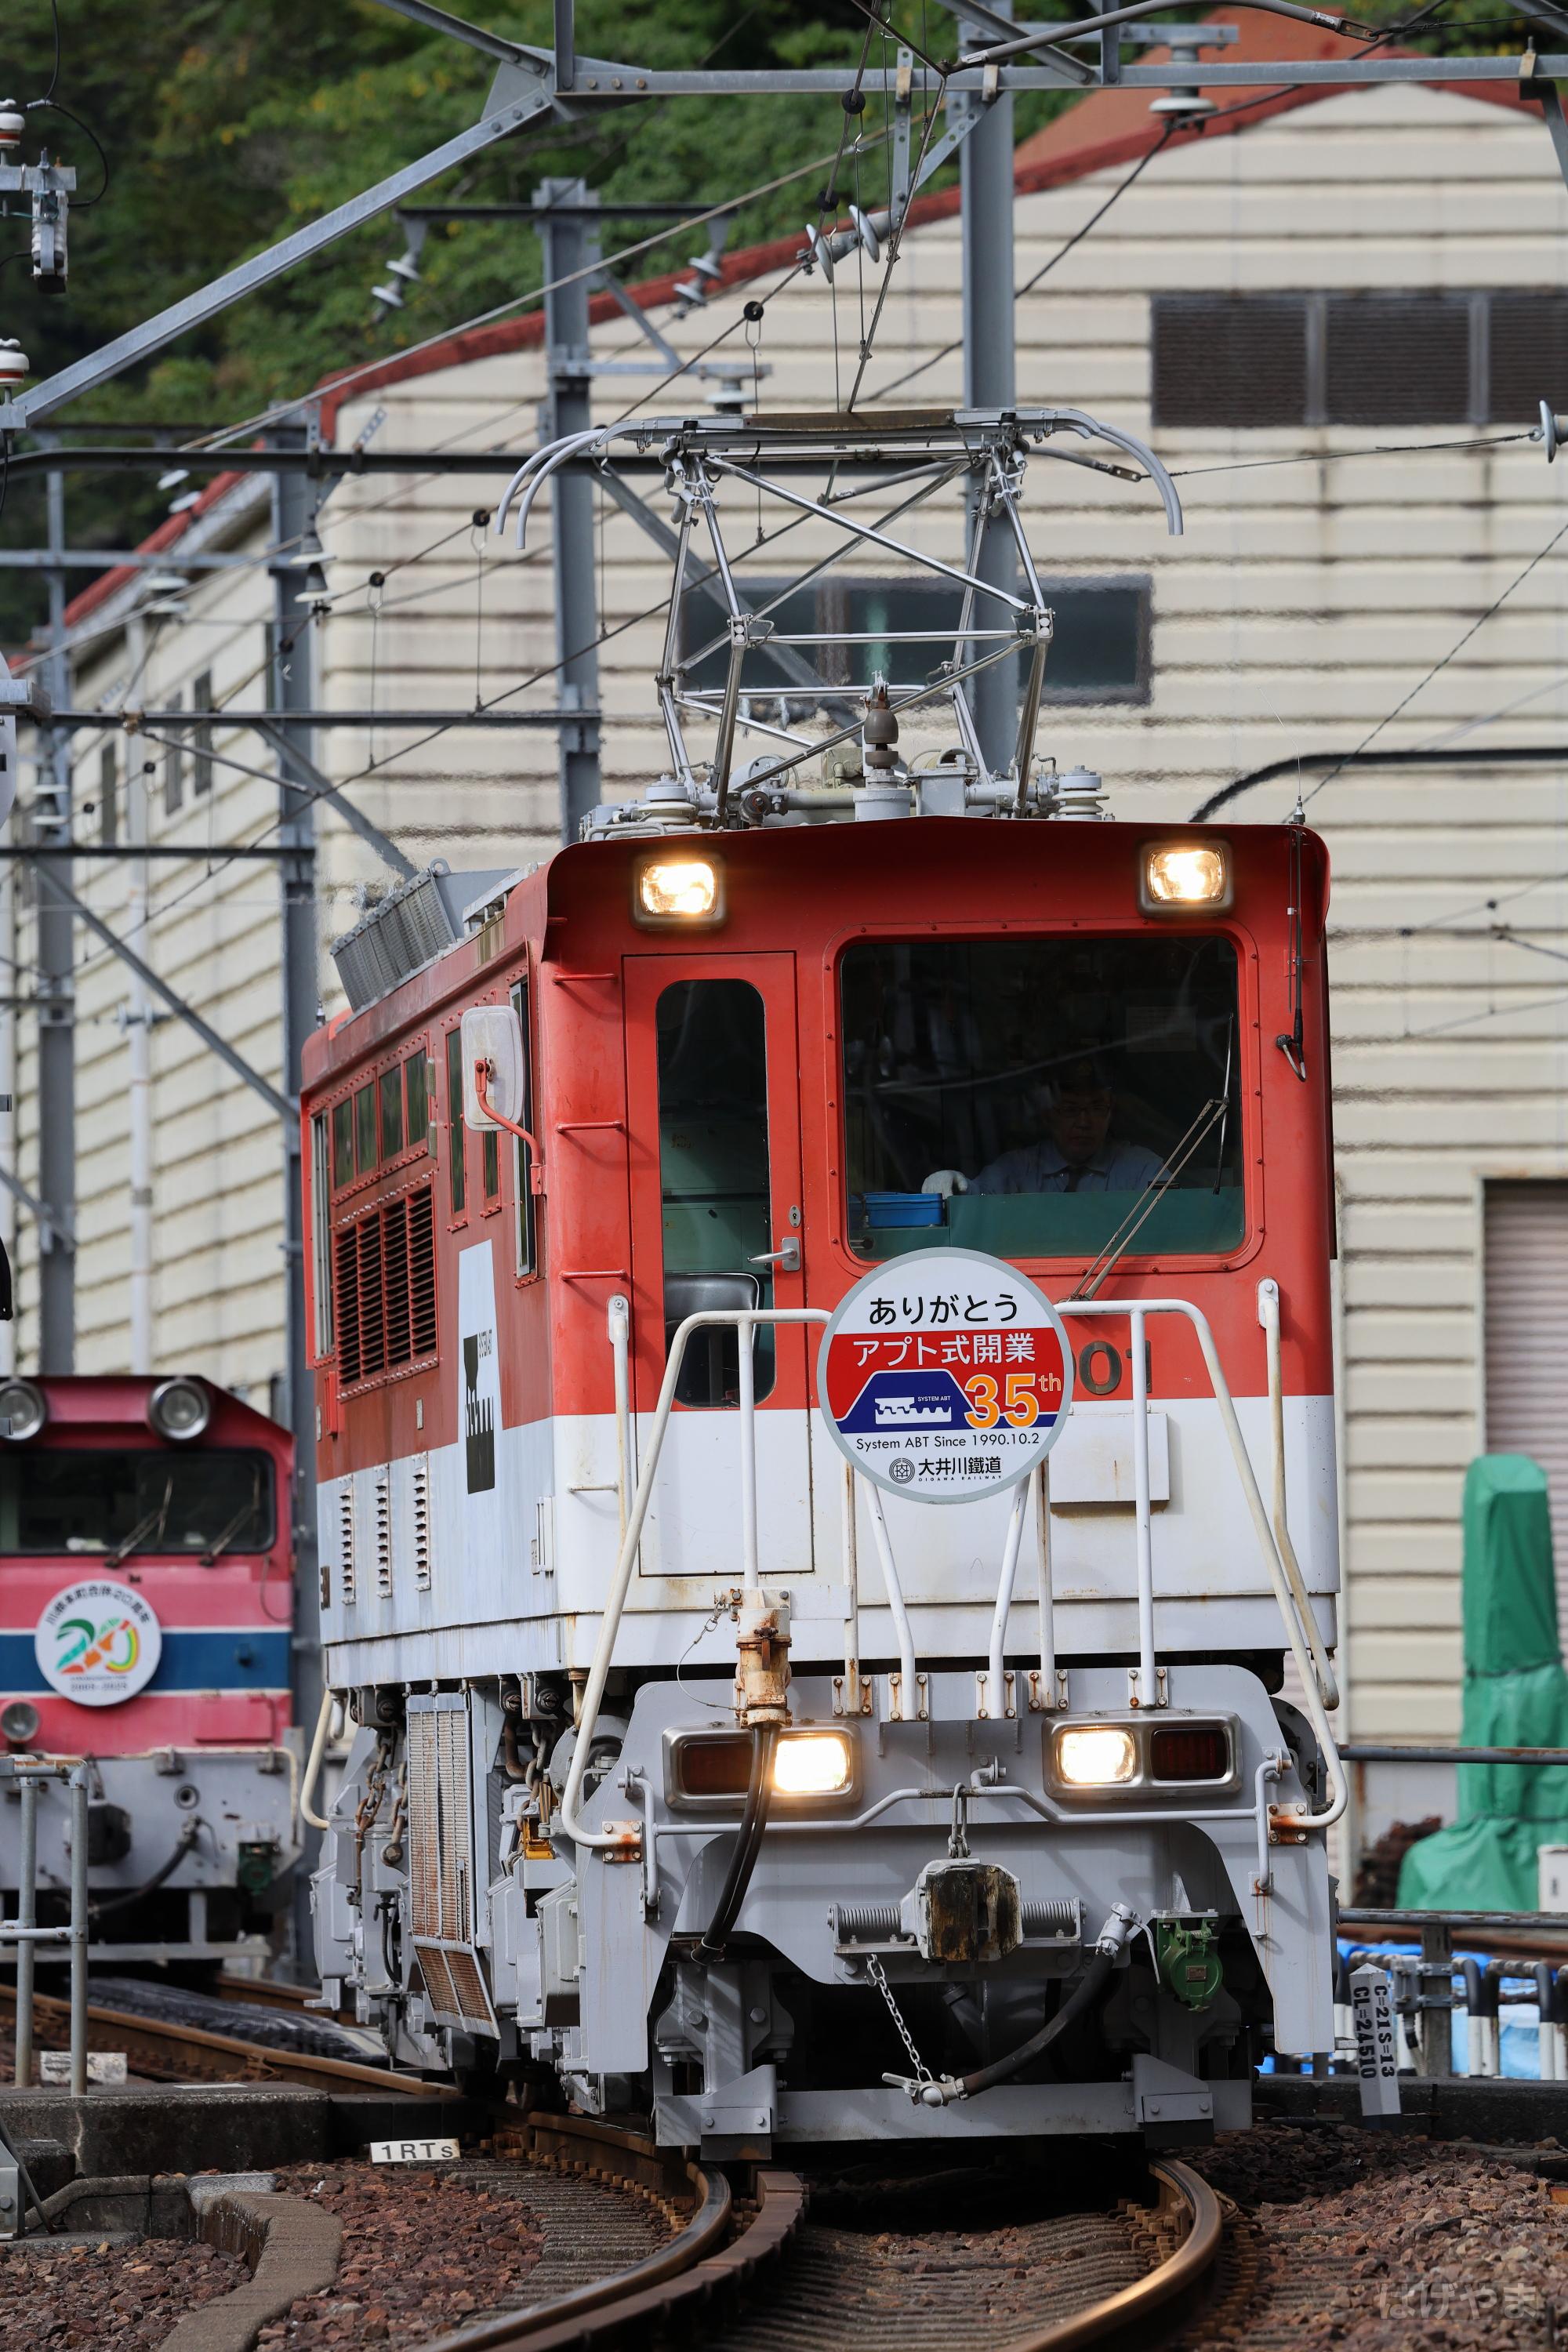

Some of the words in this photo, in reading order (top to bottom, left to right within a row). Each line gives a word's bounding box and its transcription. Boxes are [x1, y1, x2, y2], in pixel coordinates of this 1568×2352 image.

[869, 1294, 1017, 1325] ありがとう
[853, 1333, 1036, 1367] アプト式開業
[856, 1439, 900, 1452] System
[905, 1436, 930, 1448] ABT
[934, 1436, 967, 1447] Since
[972, 1432, 1040, 1446] 1990.10.2
[918, 1457, 1002, 1475] 大井川鐵道
[382, 2143, 453, 2159] 1RTs
